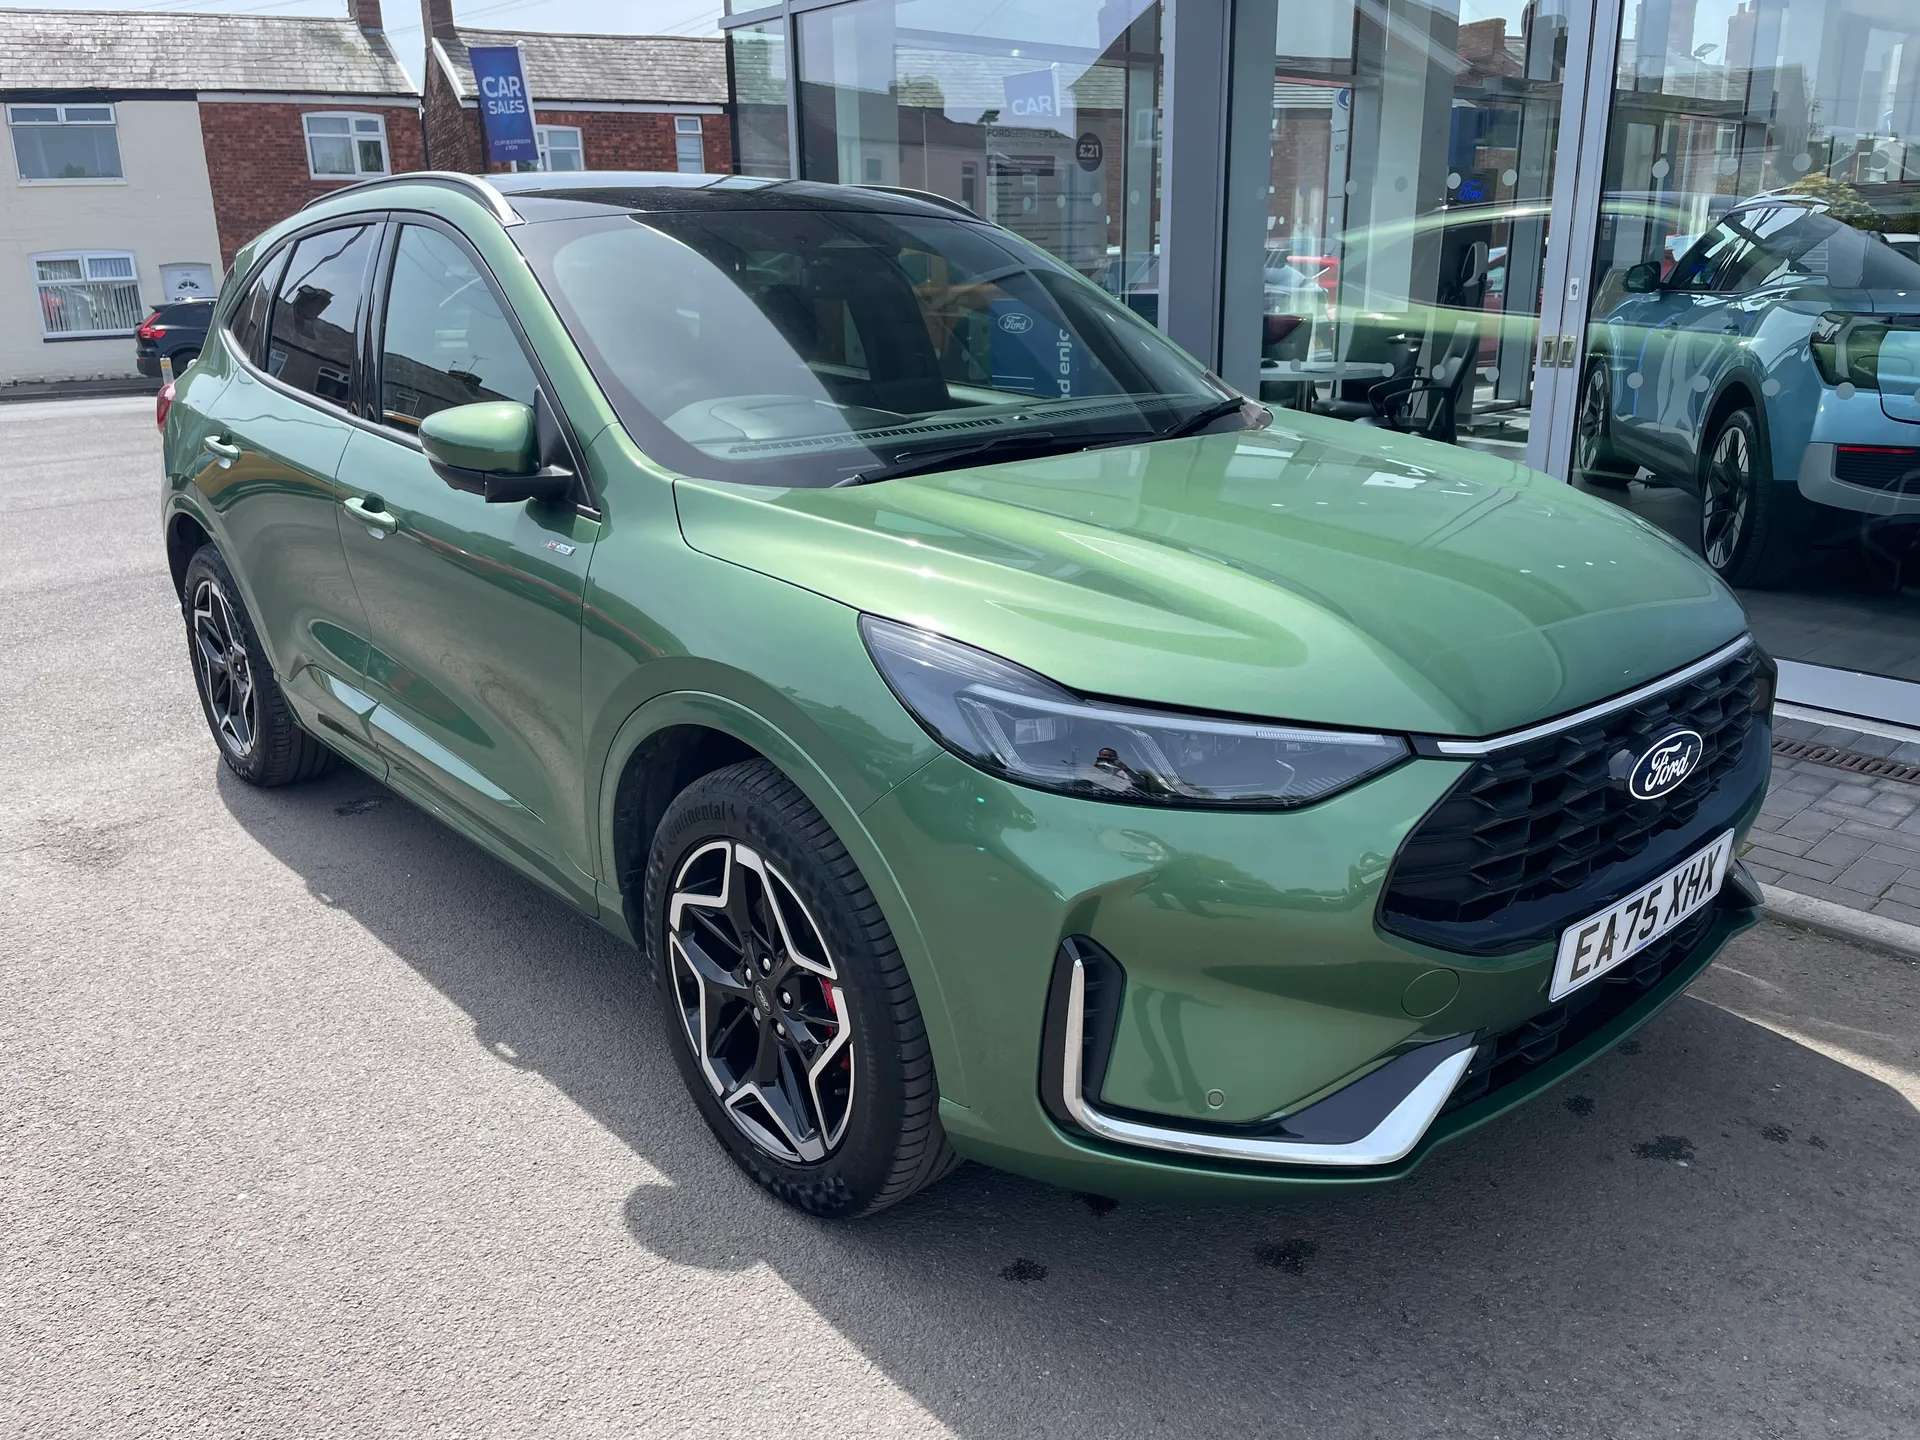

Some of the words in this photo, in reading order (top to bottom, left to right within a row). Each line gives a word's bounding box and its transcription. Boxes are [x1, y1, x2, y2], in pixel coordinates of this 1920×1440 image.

[482, 76, 522, 98] CAR
[487, 99, 526, 115] SALES
[1012, 95, 1053, 116] CAR
[1079, 144, 1100, 158] £21
[1643, 740, 1694, 793] Ford
[1569, 885, 1664, 983] EA75
[1663, 844, 1723, 925] XHX
